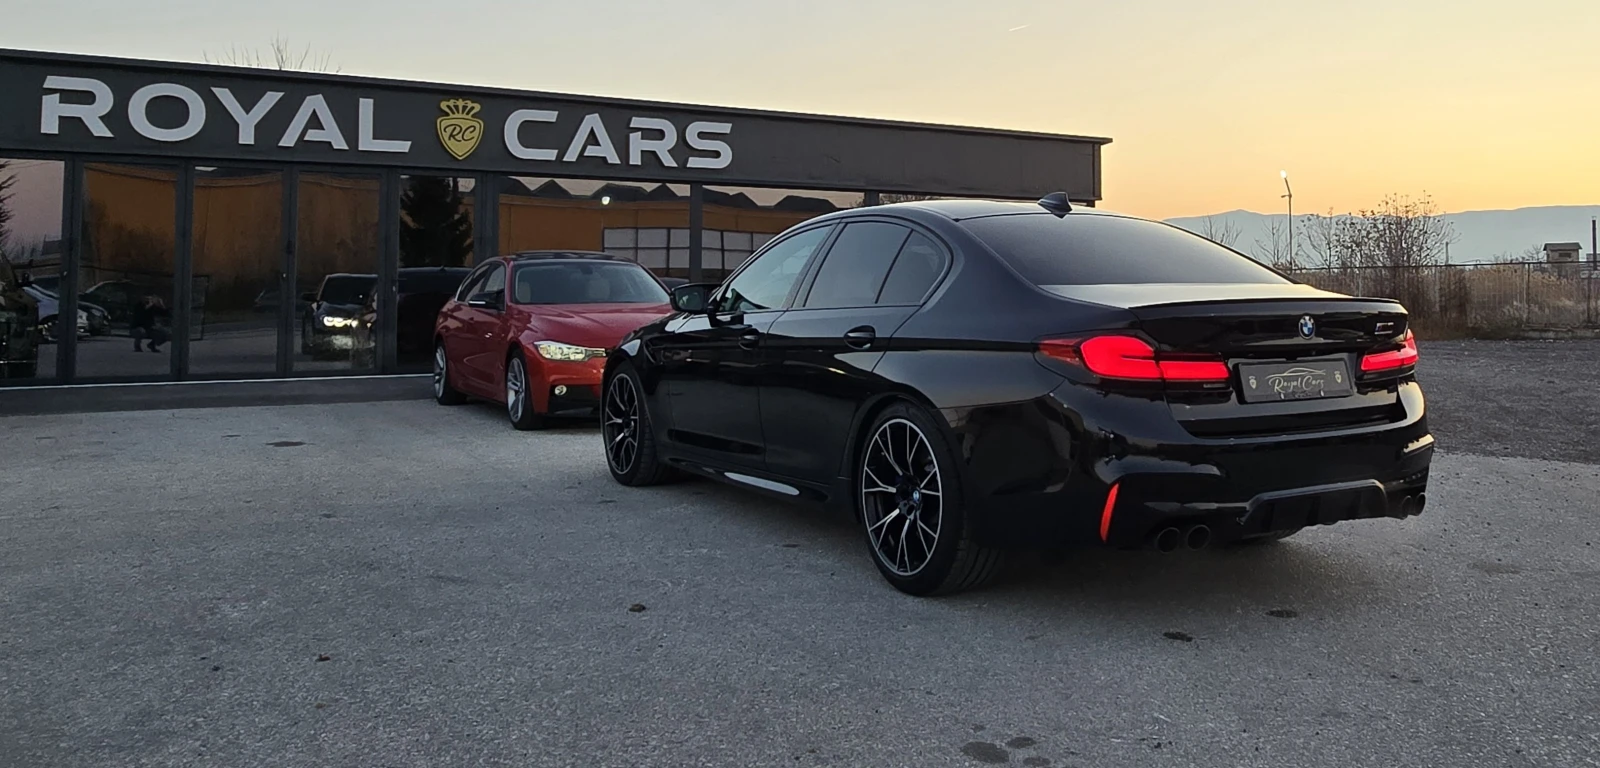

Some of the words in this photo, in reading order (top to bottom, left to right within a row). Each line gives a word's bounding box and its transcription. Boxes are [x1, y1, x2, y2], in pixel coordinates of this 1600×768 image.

[40, 75, 412, 153] ROYAL
[503, 108, 733, 169] CARS
[443, 123, 477, 142] RC
[1268, 376, 1302, 393] Royal
[1302, 375, 1324, 390] Cars
